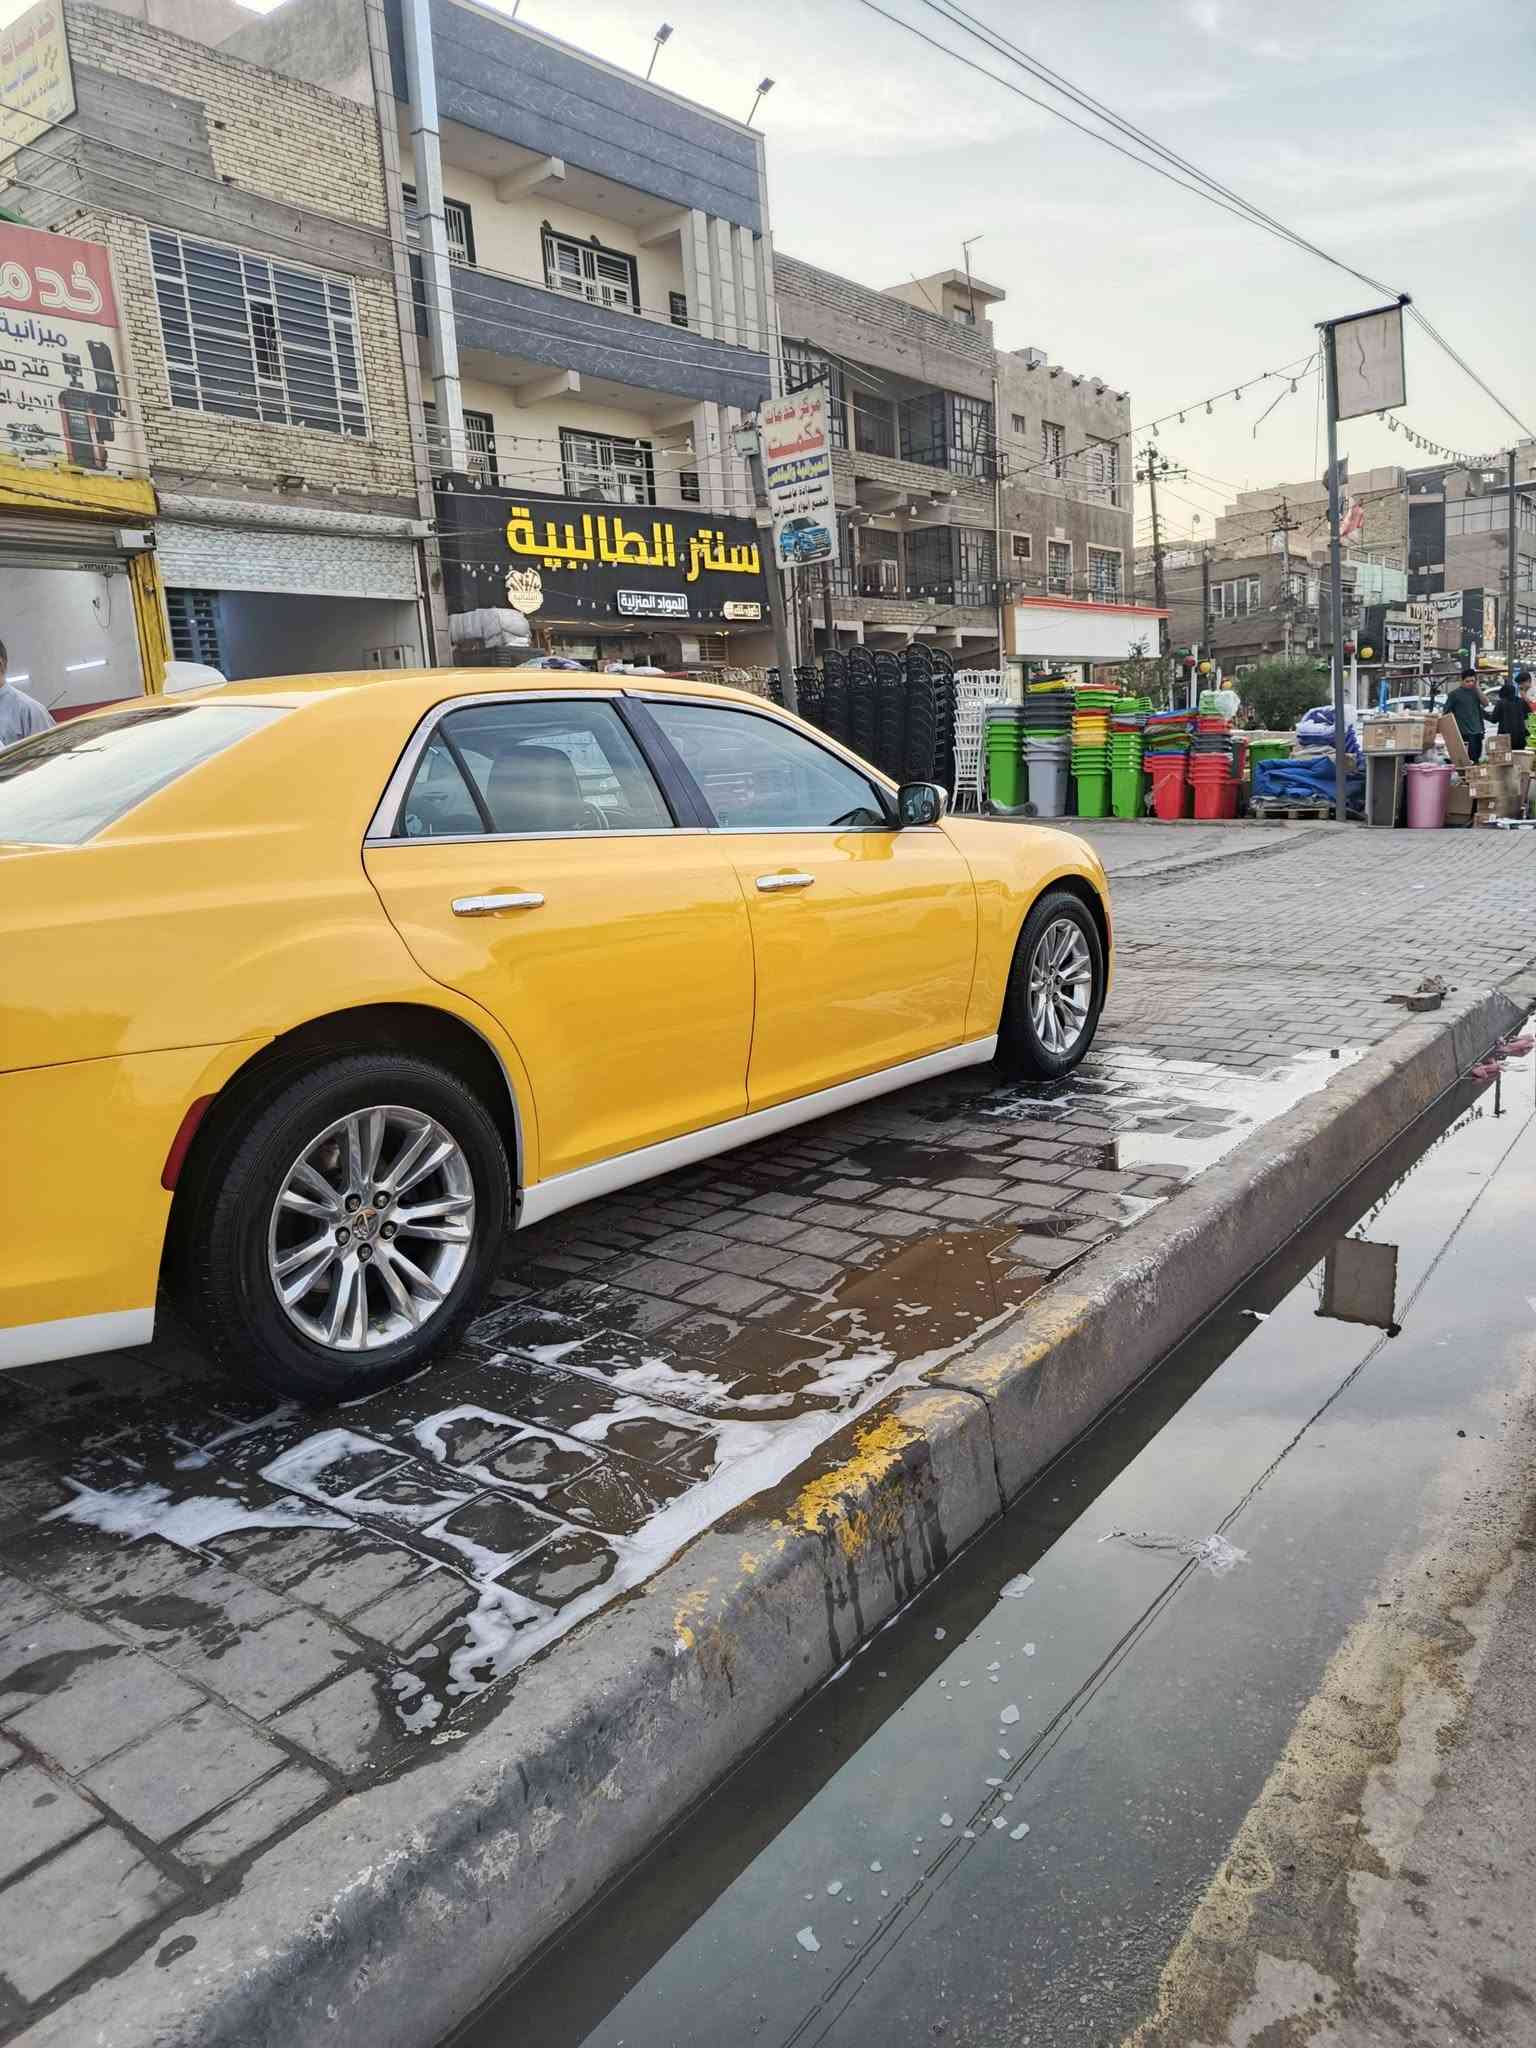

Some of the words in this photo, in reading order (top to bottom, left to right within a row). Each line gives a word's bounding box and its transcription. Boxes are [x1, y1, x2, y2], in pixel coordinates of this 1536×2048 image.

[507, 506, 676, 570] الطالبية
[687, 528, 761, 582] سنتر
[621, 593, 656, 610] المنزلية
[657, 596, 685, 612] للمواد
